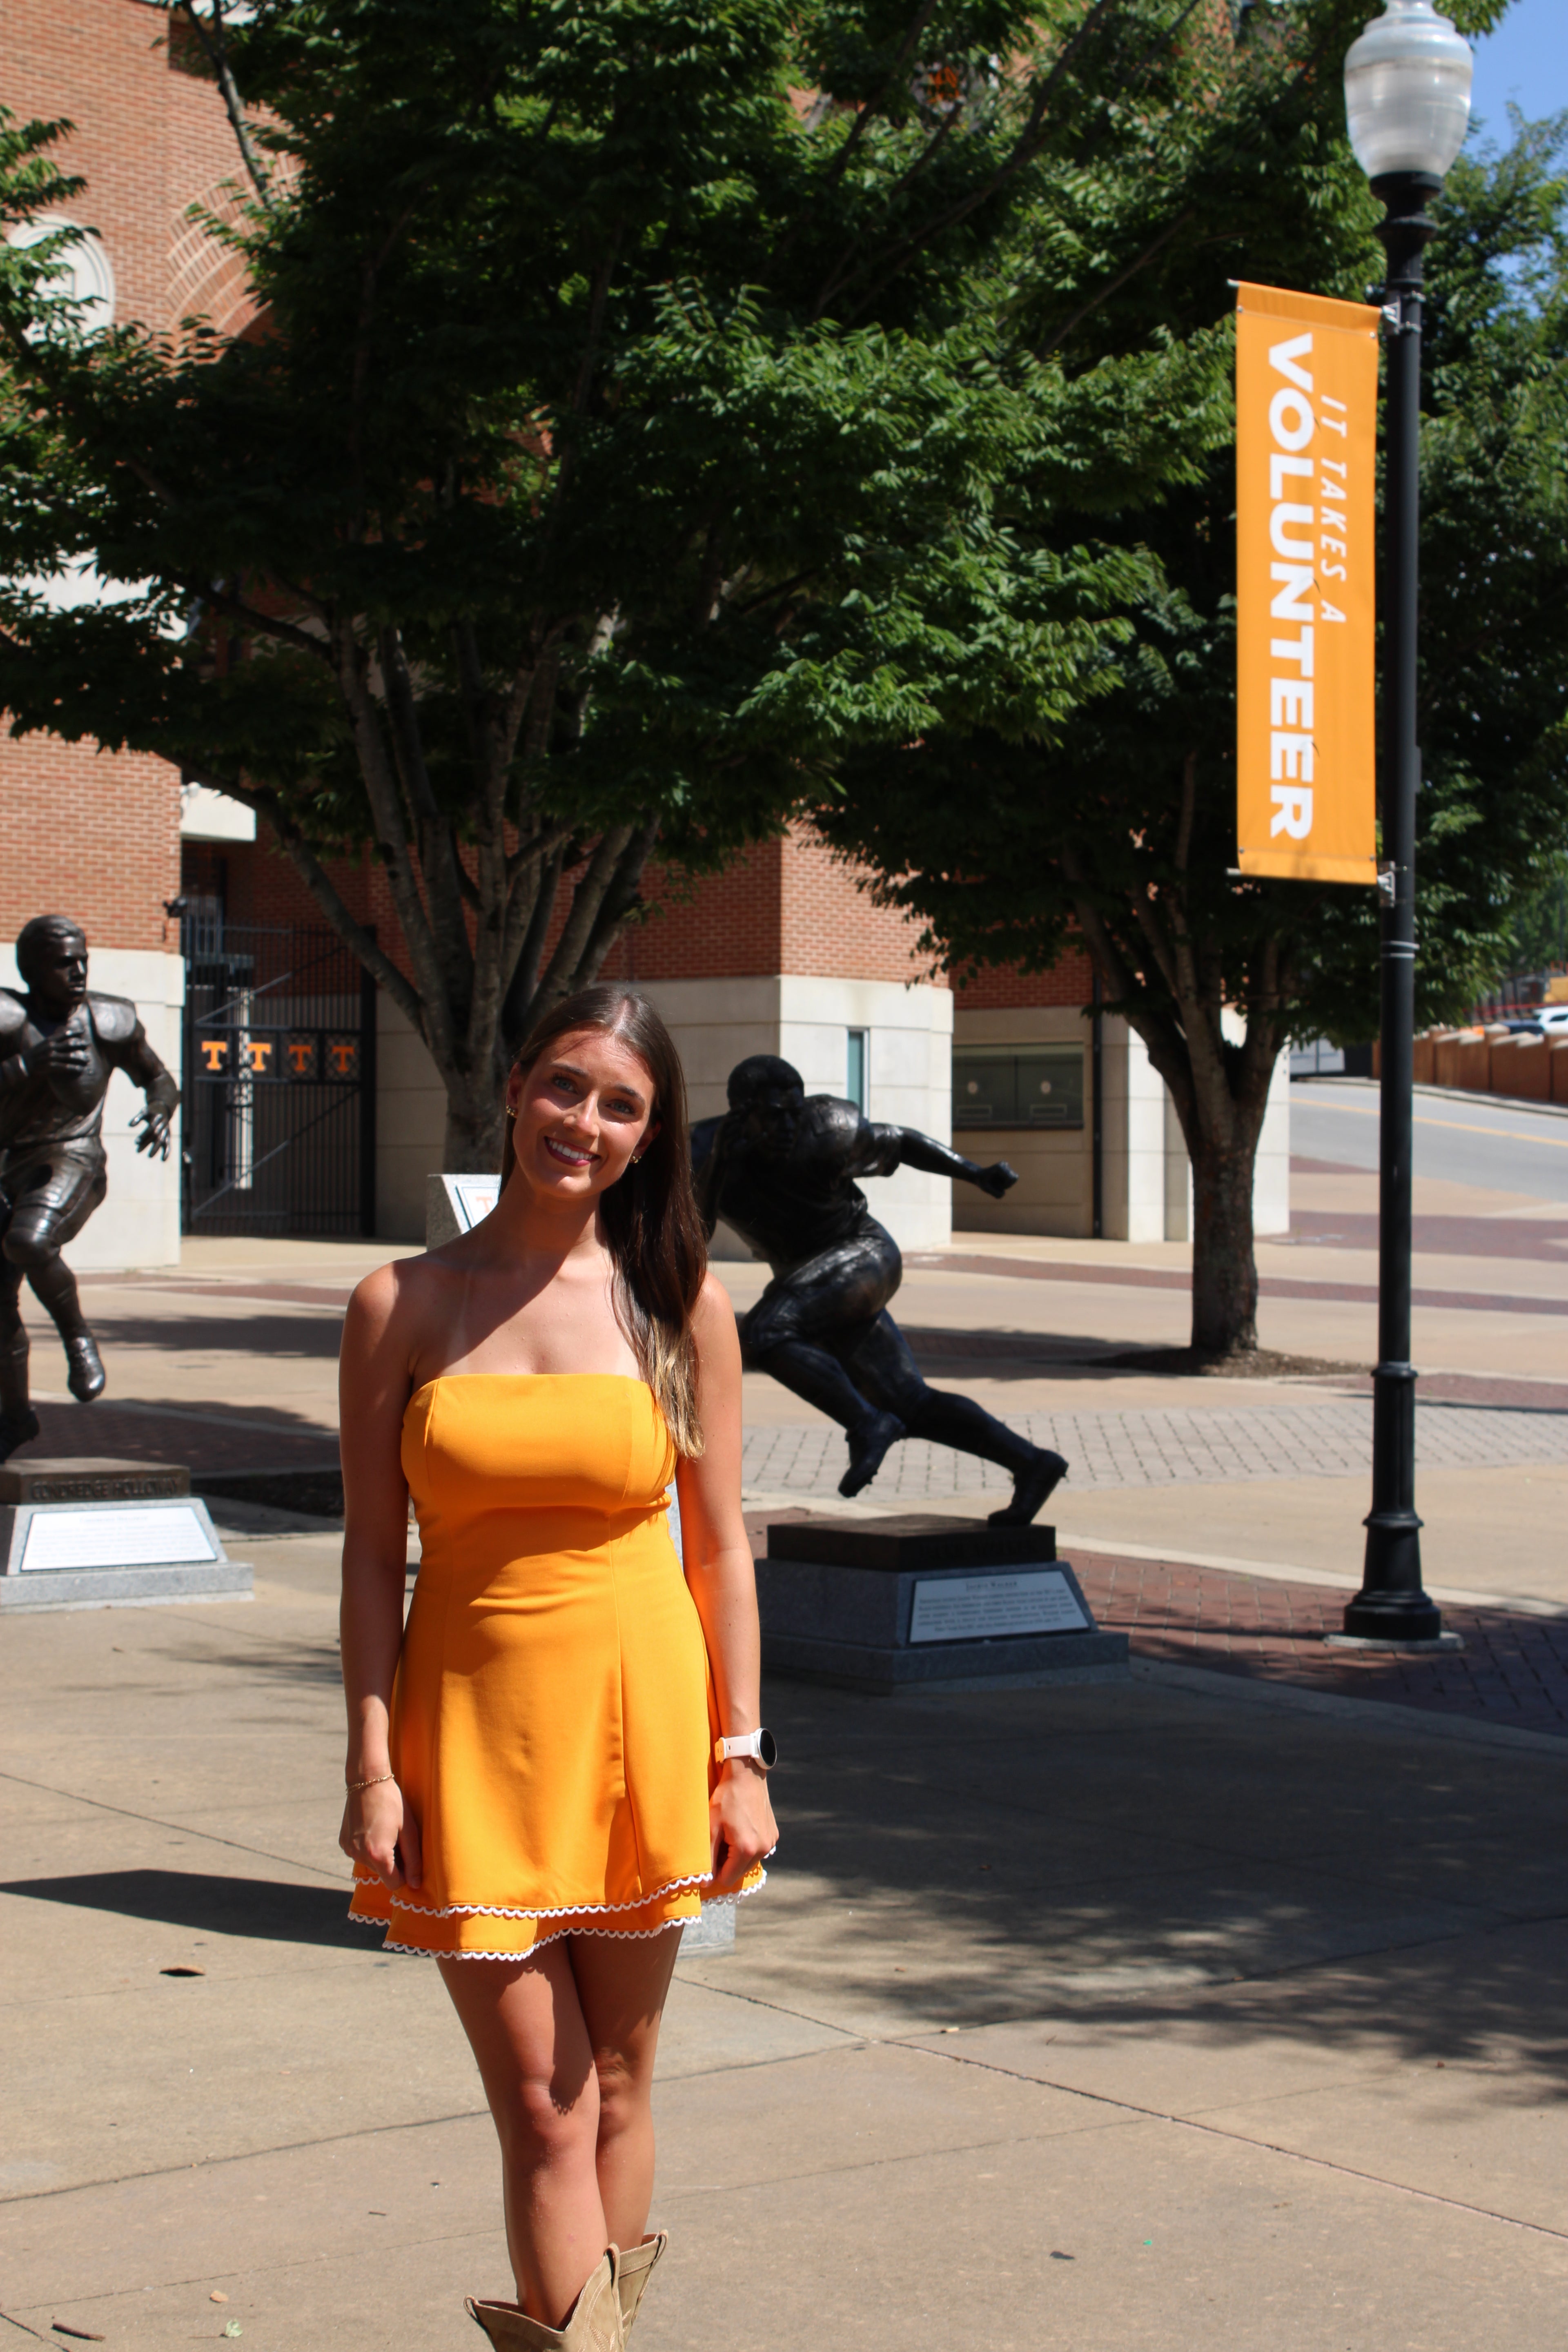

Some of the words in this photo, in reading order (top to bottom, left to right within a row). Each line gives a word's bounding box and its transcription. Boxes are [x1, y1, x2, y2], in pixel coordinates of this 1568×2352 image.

[1320, 393, 1348, 438] IT
[1320, 457, 1348, 582] TAKES
[1268, 332, 1315, 841] VOLUNTEER
[1320, 599, 1347, 624] A
[202, 1041, 227, 1069] T
[247, 1043, 271, 1071] T
[289, 1045, 312, 1071] T
[332, 1045, 354, 1071] T
